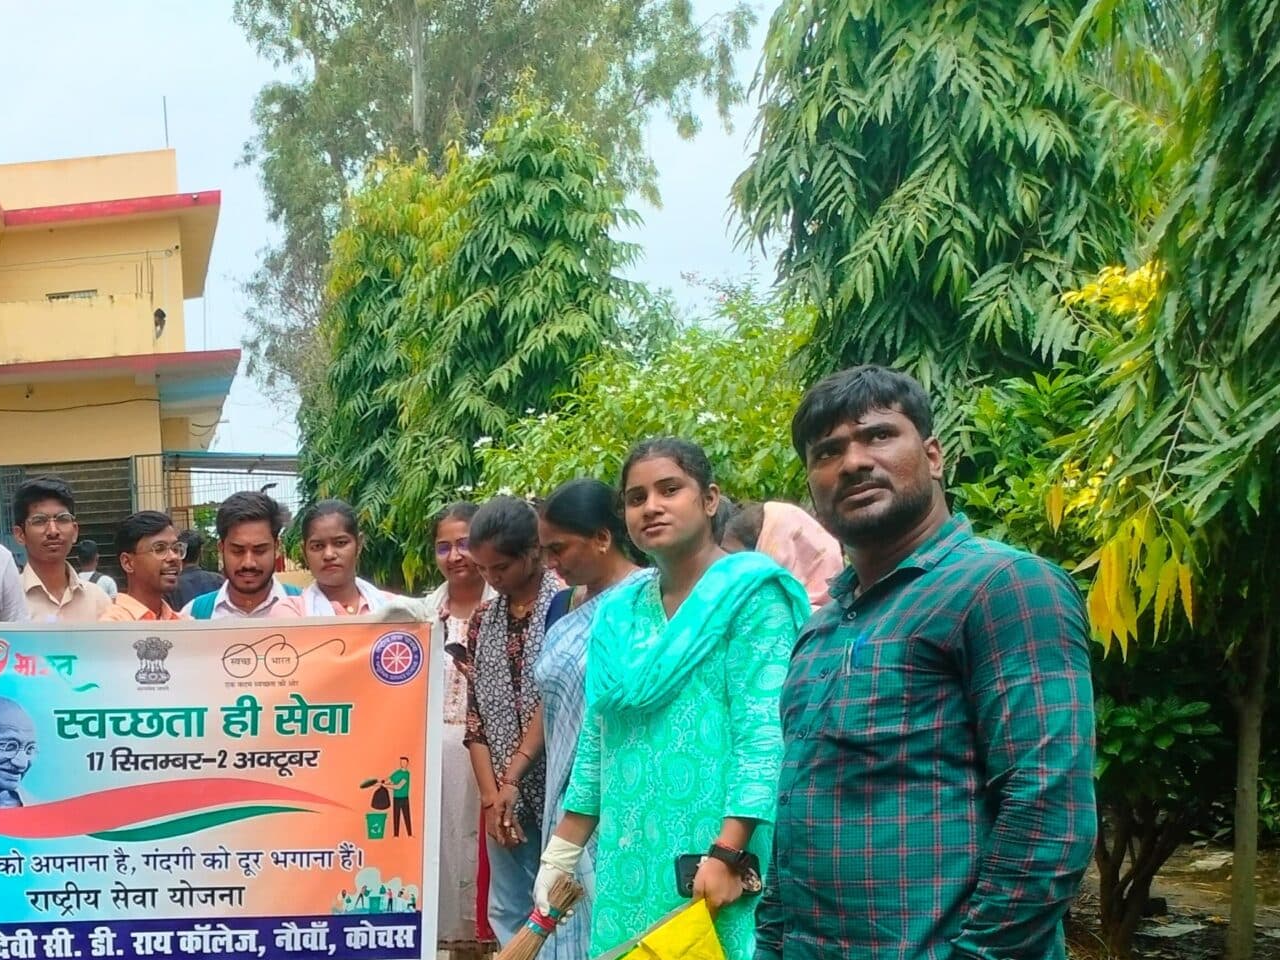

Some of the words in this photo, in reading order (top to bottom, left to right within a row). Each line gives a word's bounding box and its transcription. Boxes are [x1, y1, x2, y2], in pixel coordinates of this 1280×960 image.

[54, 707, 208, 740] स्वच्छता
[221, 694, 262, 738] ही
[274, 693, 354, 736] सेवा
[86, 751, 105, 772] 17
[233, 750, 320, 776] अक्टूबर
[30, 854, 109, 874] अपनाना
[114, 847, 136, 875] है,
[141, 847, 196, 873] गंदगी
[201, 845, 231, 870] को
[236, 851, 263, 876] दूर
[270, 850, 335, 870] भगाना
[26, 881, 101, 916] राष्ट्रीय
[110, 881, 158, 910] सेवा
[167, 880, 246, 907] योजना
[40, 927, 82, 959] सी.
[88, 926, 124, 957] डी.
[131, 930, 174, 956] राय
[177, 923, 266, 957] कॉलेज,
[343, 920, 417, 950] कोचस
